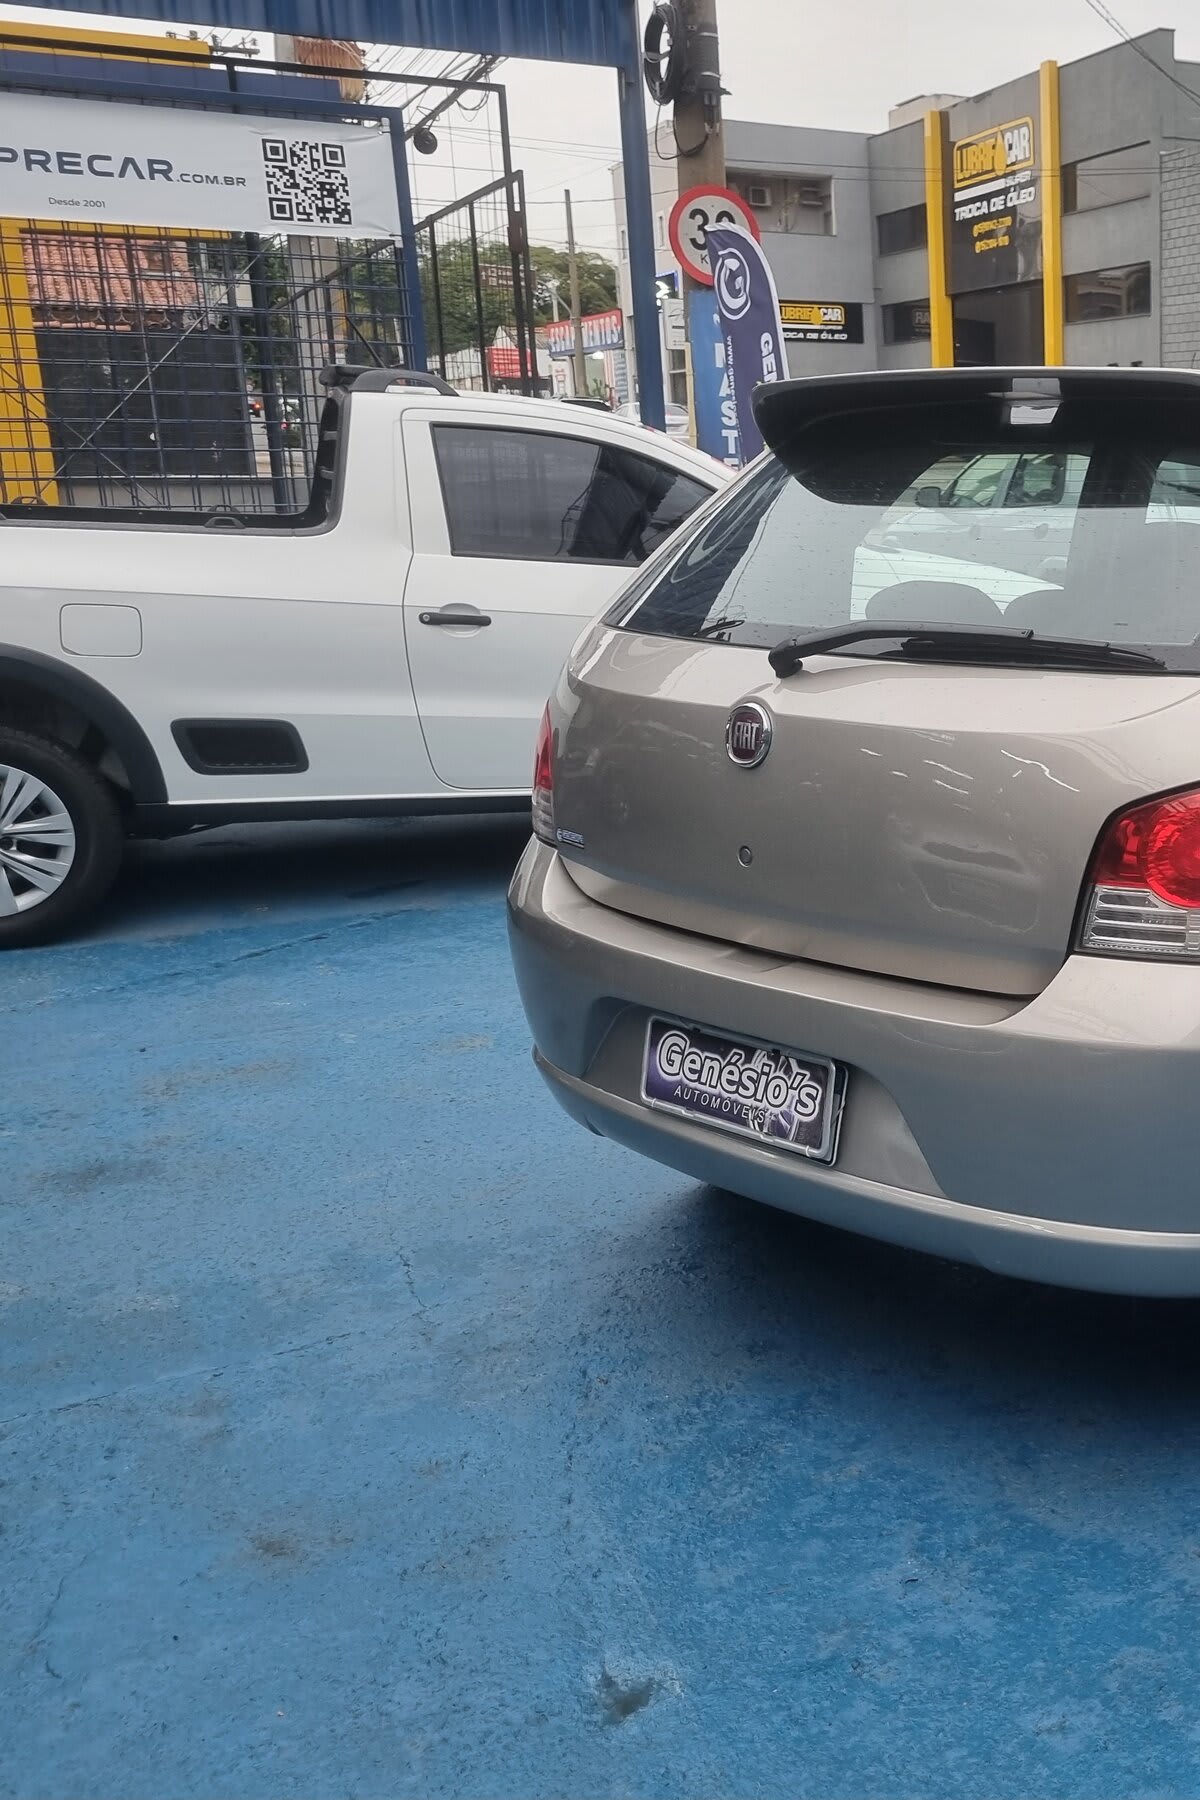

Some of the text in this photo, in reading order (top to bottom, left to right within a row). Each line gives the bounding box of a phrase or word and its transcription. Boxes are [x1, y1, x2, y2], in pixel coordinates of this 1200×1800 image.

[48, 197, 106, 208] Desde 2001
[954, 187, 1036, 222] TROCA DE ÓLEO
[820, 330, 848, 340] ÓLEO
[733, 720, 760, 750] FIAT
[658, 1032, 820, 1117] Genésio's
[674, 1085, 766, 1123] AUTOMÓVEIS
